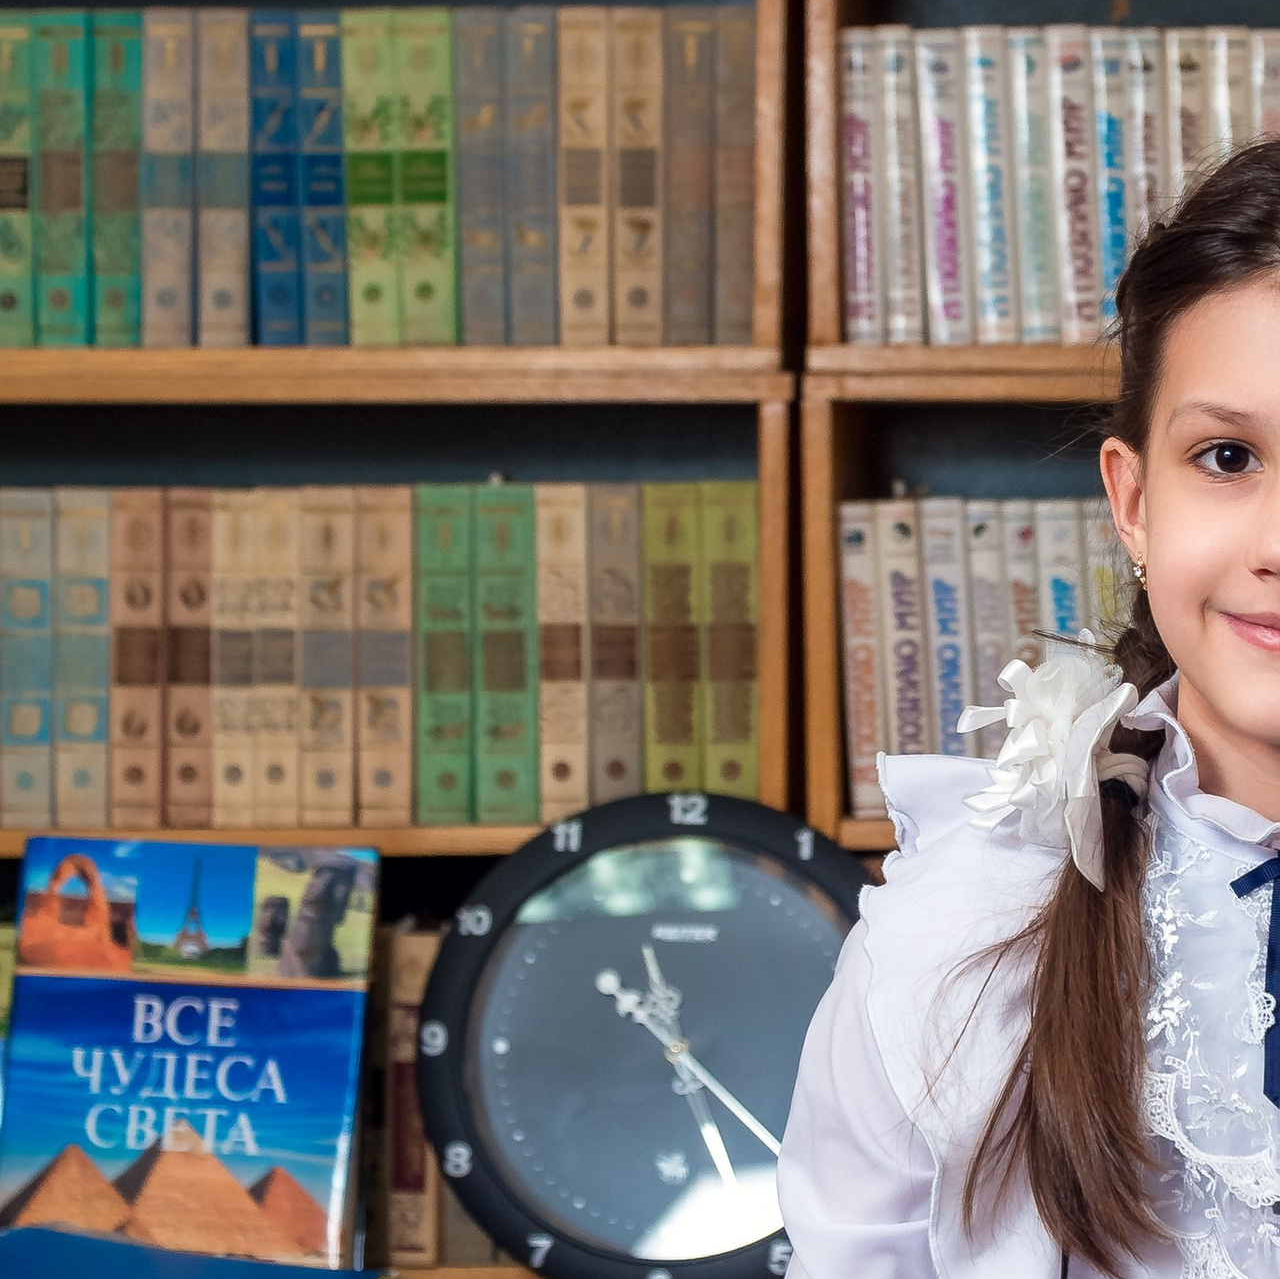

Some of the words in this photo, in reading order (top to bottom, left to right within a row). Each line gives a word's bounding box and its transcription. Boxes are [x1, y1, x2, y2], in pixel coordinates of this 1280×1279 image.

[667, 794, 708, 826] 12
[552, 821, 582, 852] 11
[795, 829, 815, 861] 1
[458, 905, 492, 936] 10
[132, 993, 240, 1048] ВСЕ
[421, 1021, 448, 1056] 9
[72, 1046, 288, 1104] ЧУДЕСА
[84, 1102, 261, 1157] СВЕТА
[443, 1141, 473, 1178] 8
[527, 1232, 554, 1269] 7
[767, 1240, 792, 1276] 5
